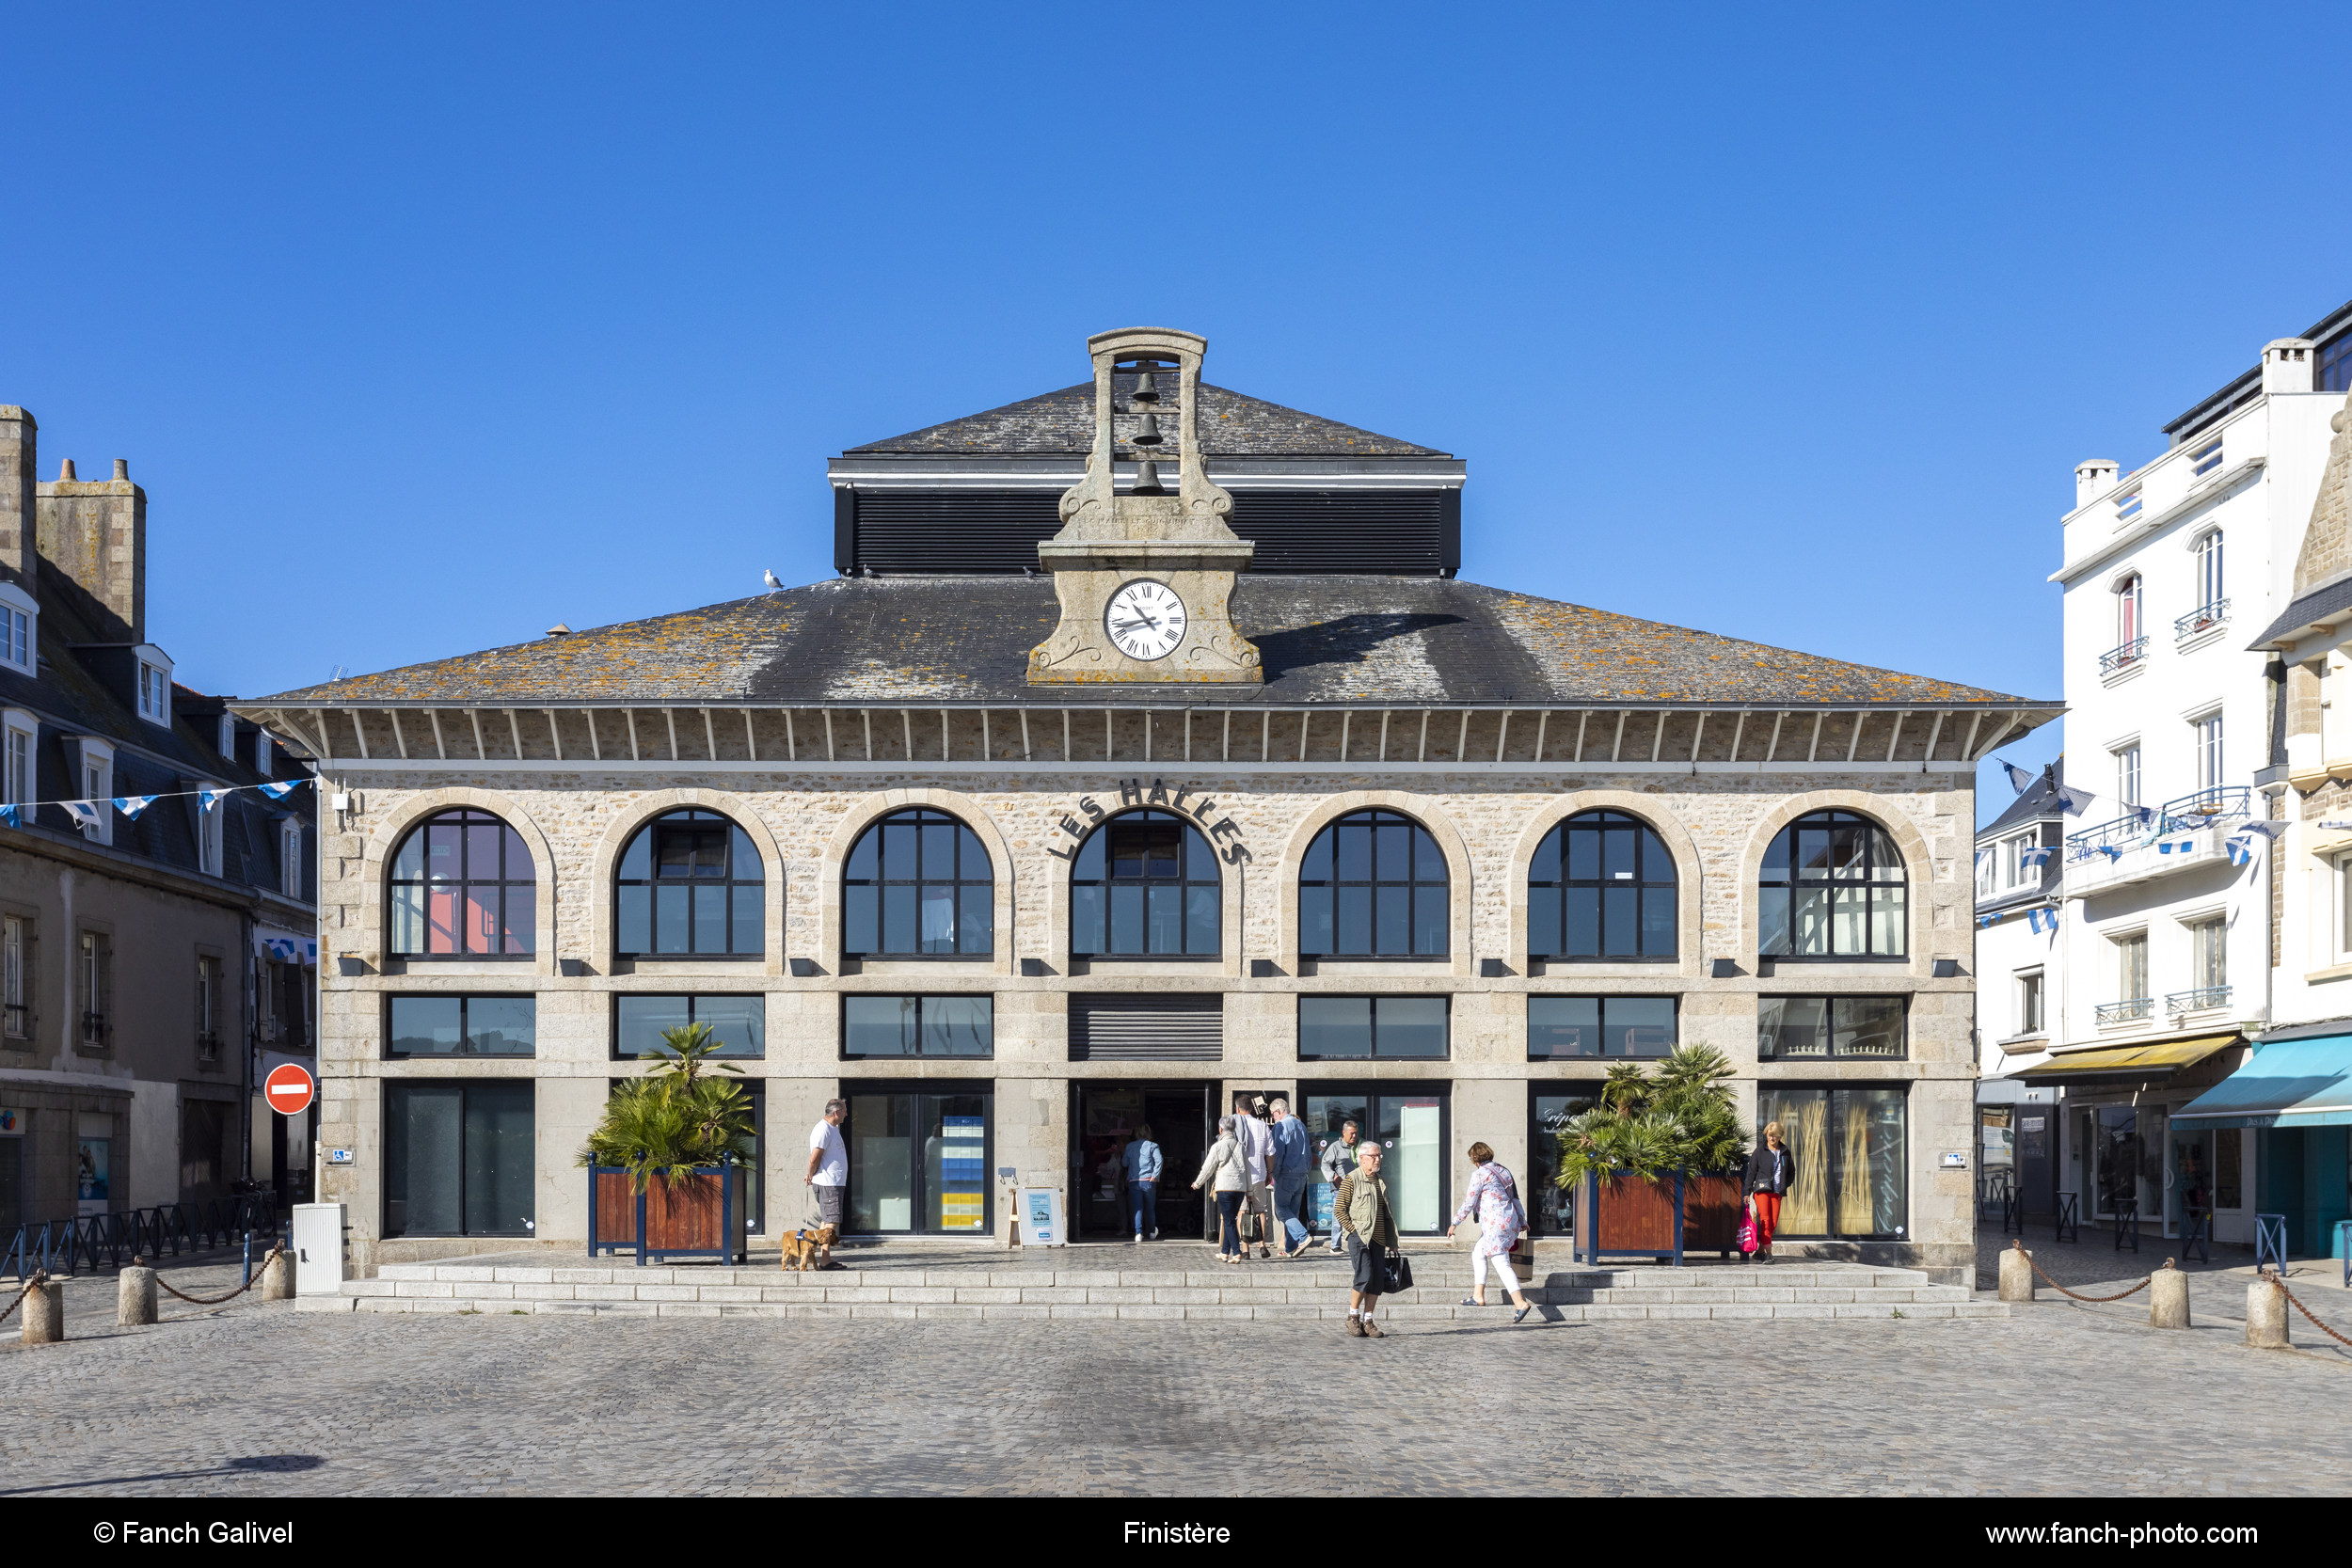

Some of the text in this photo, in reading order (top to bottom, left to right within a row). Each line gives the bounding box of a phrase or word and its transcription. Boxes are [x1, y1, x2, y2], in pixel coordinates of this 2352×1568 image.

[1047, 778, 1253, 866] LES HALLES
[1875, 1127, 1899, 1234] Crêperie
